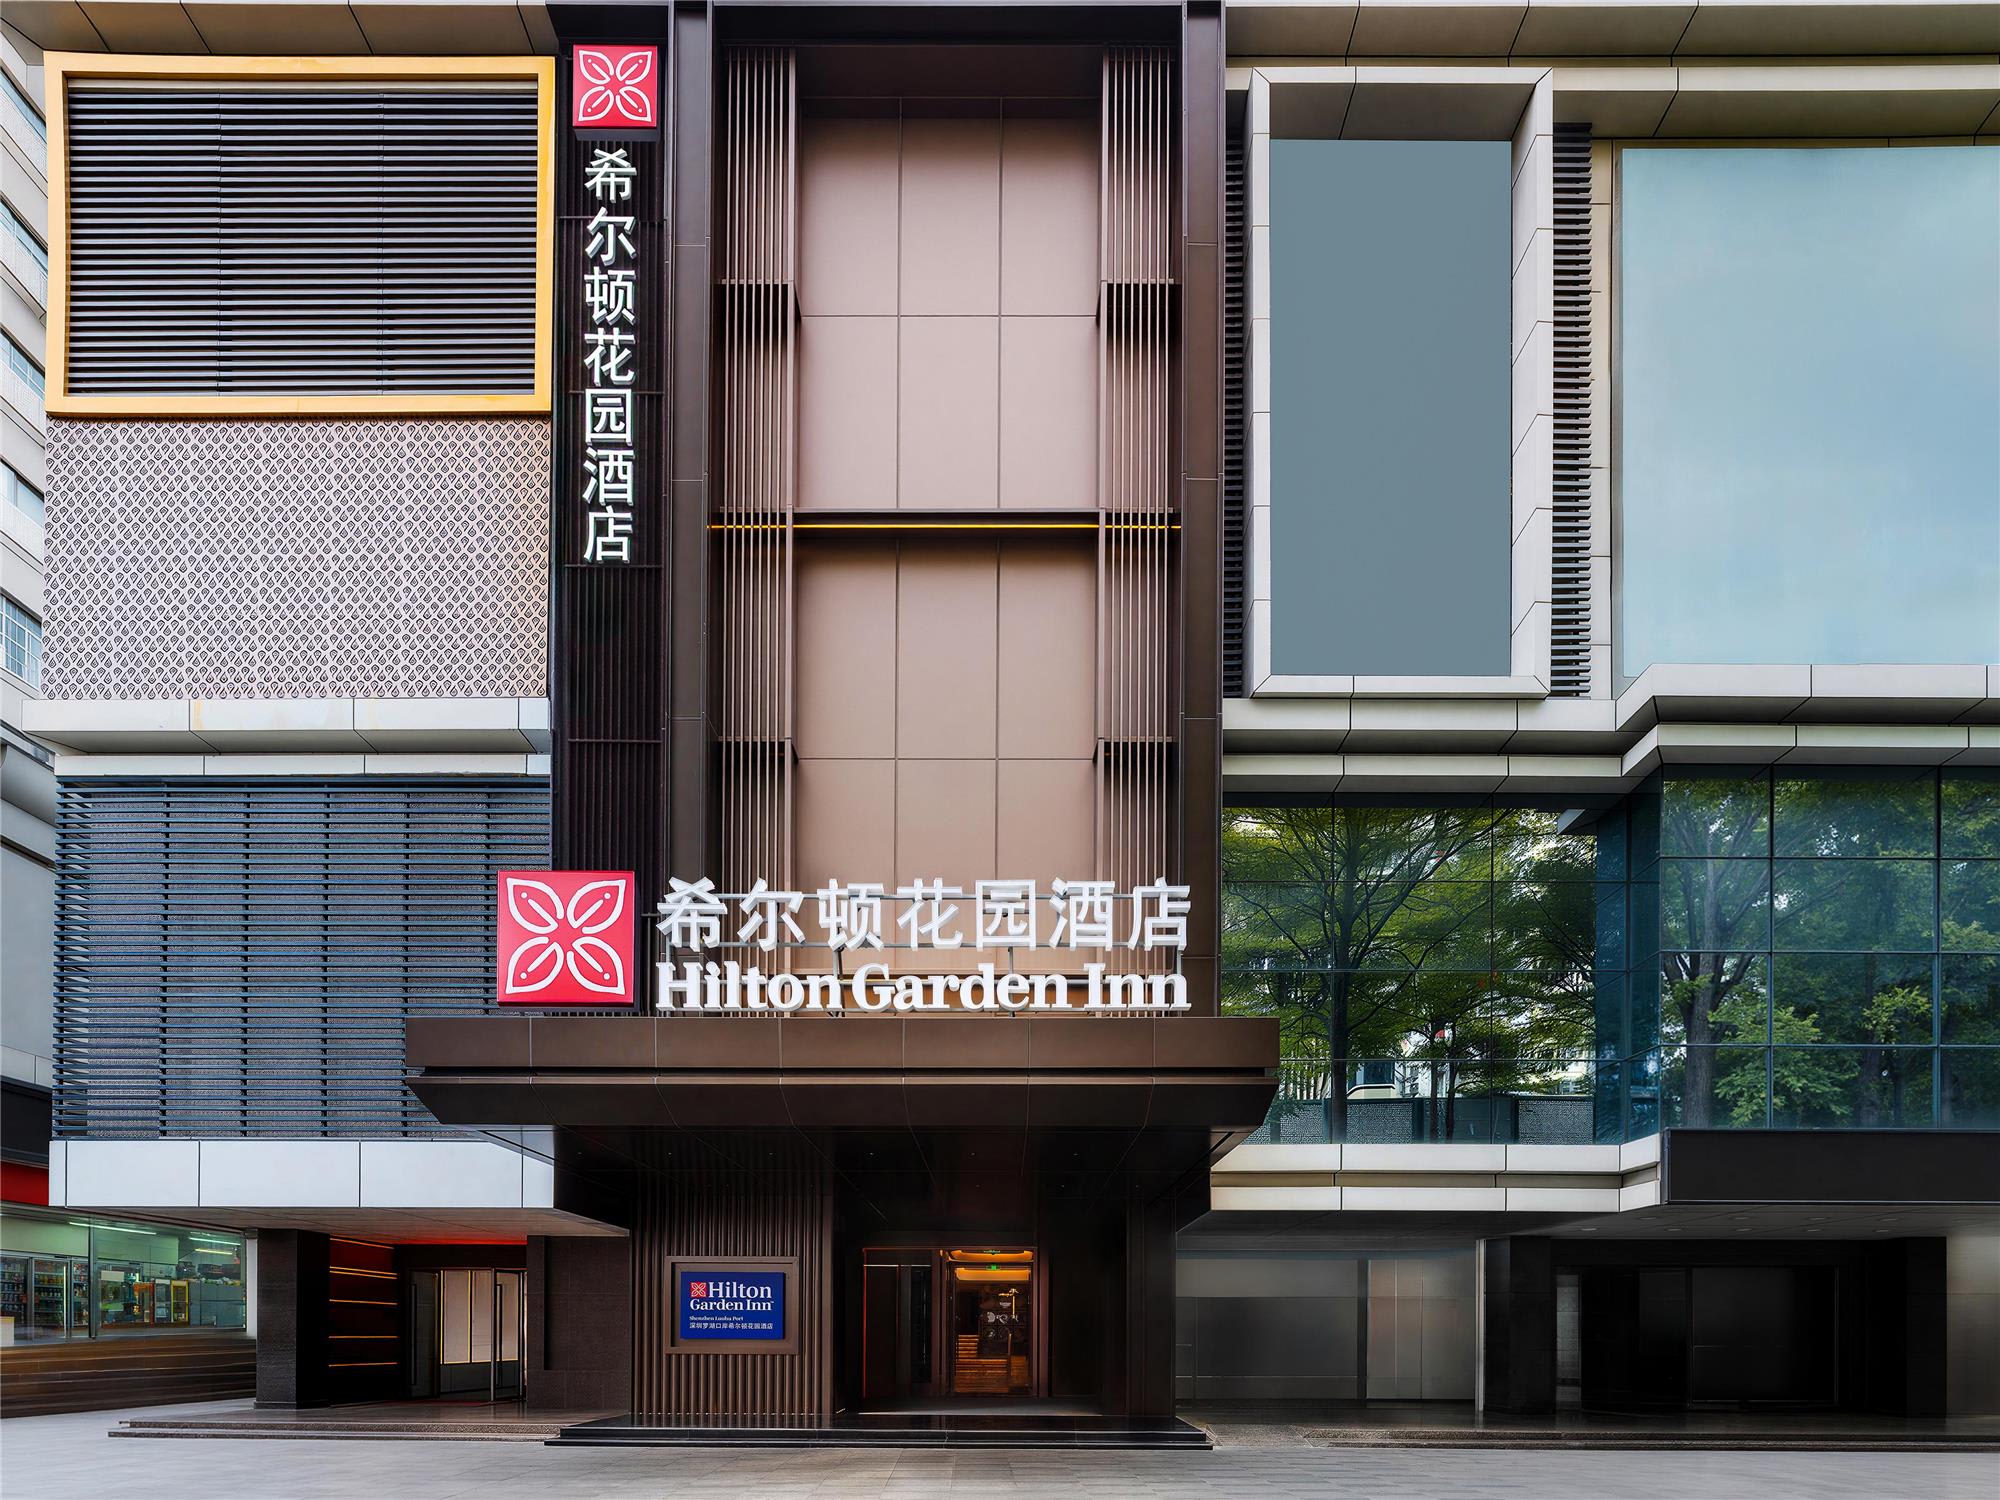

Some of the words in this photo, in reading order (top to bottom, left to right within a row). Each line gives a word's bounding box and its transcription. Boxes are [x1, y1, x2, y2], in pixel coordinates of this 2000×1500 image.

[583, 148, 637, 564] 希尔顿花园酒店
[656, 877, 1192, 952] 希尔顿花园酒店
[655, 961, 843, 1012] Hilton
[851, 962, 1073, 1012] Garden
[1082, 963, 1191, 1012] Inn
[689, 1298, 744, 1311] Garden
[708, 1281, 772, 1299] Hilton
